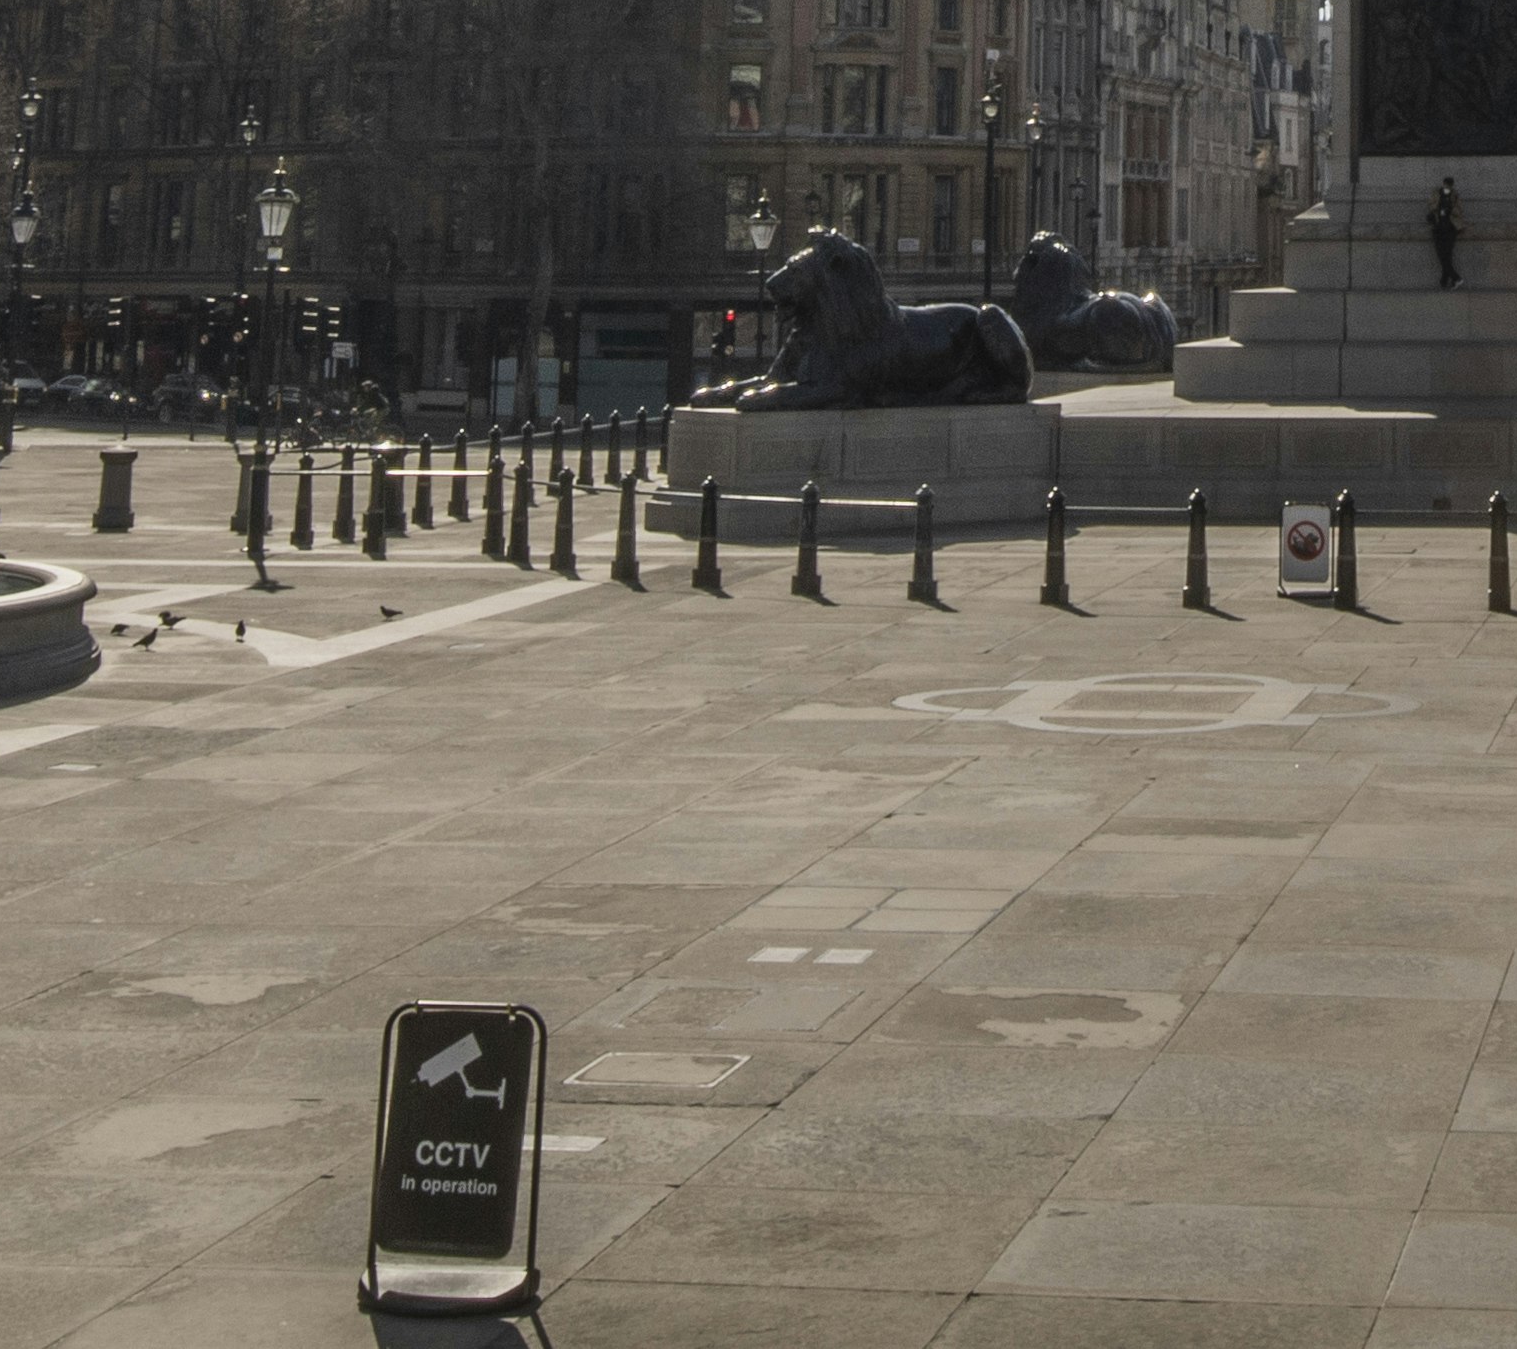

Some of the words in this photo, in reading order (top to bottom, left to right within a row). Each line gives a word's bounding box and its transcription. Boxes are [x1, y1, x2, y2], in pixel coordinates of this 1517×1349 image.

[415, 1140, 490, 1168] CCTV
[400, 1174, 416, 1190] in
[421, 1177, 498, 1196] operation
